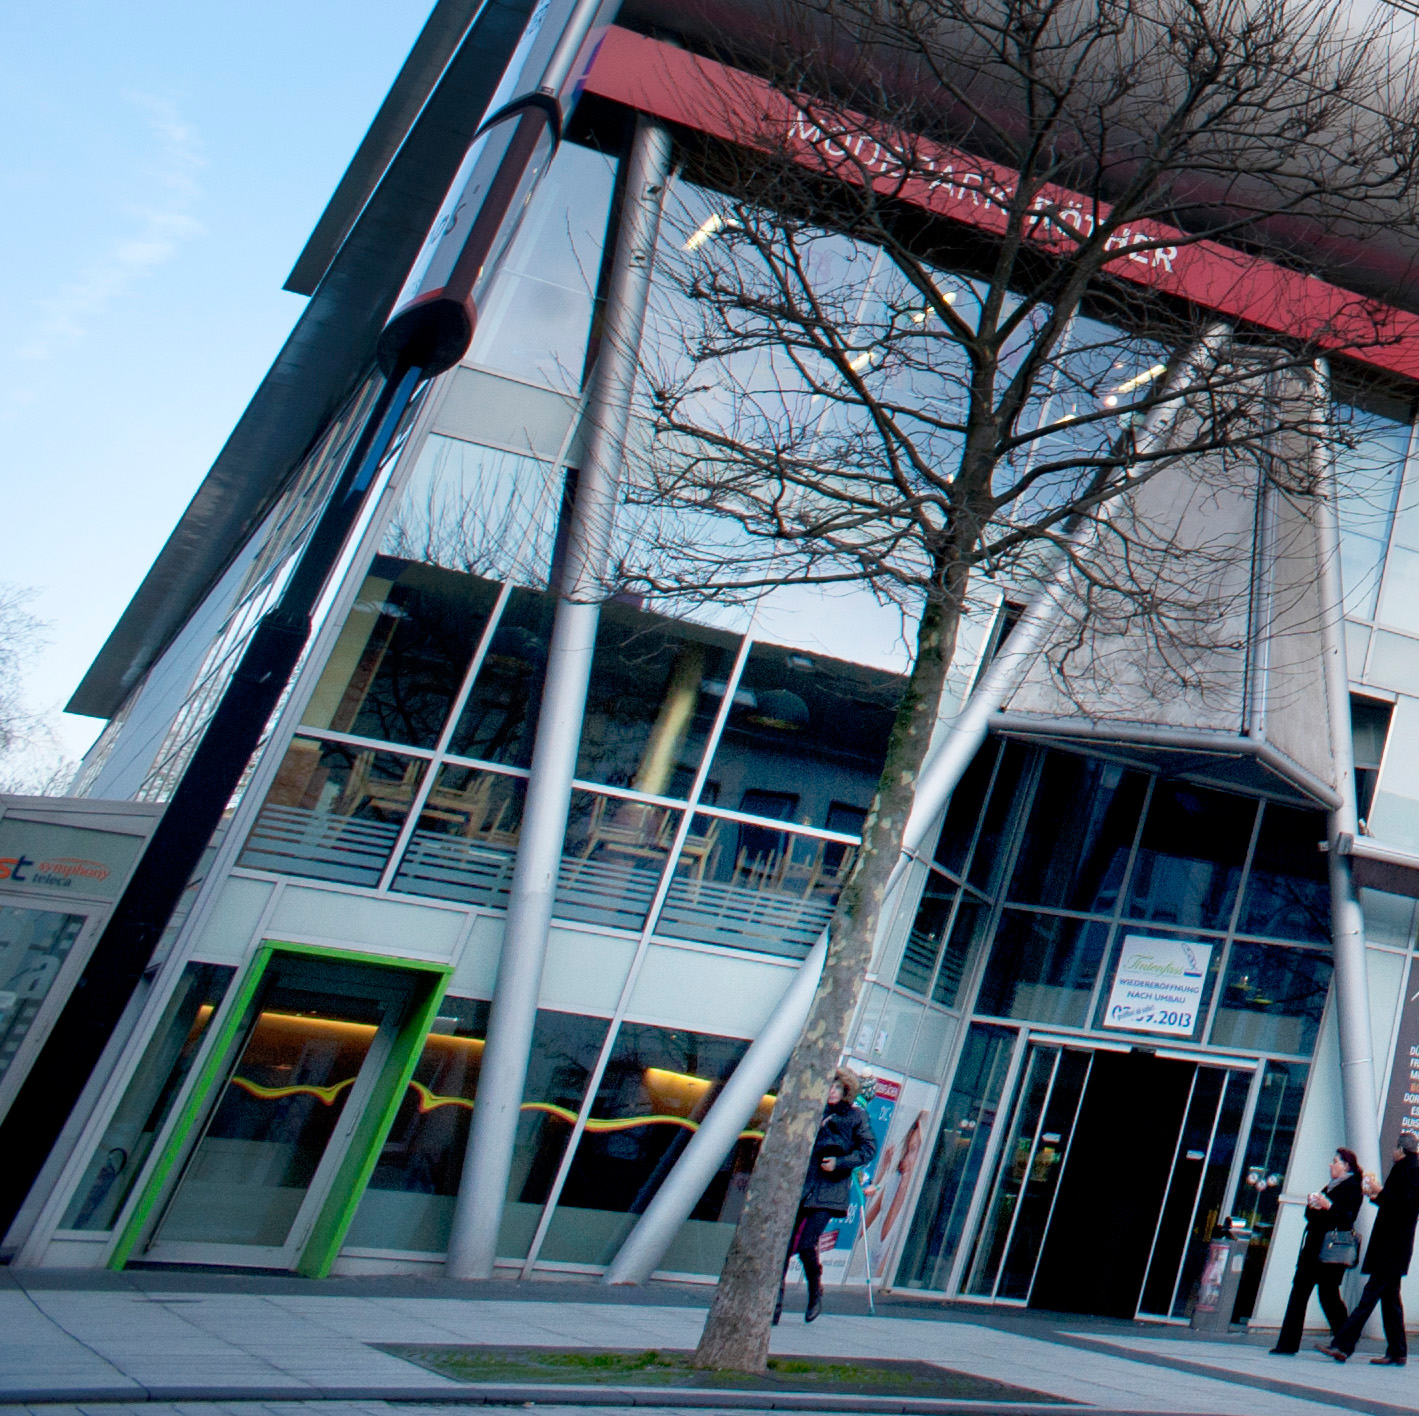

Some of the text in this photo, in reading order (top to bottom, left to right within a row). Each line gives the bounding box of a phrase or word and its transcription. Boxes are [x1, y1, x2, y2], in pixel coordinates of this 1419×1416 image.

[32, 872, 72, 887] teleca
[1126, 990, 1186, 1004] NACH UMBAU
